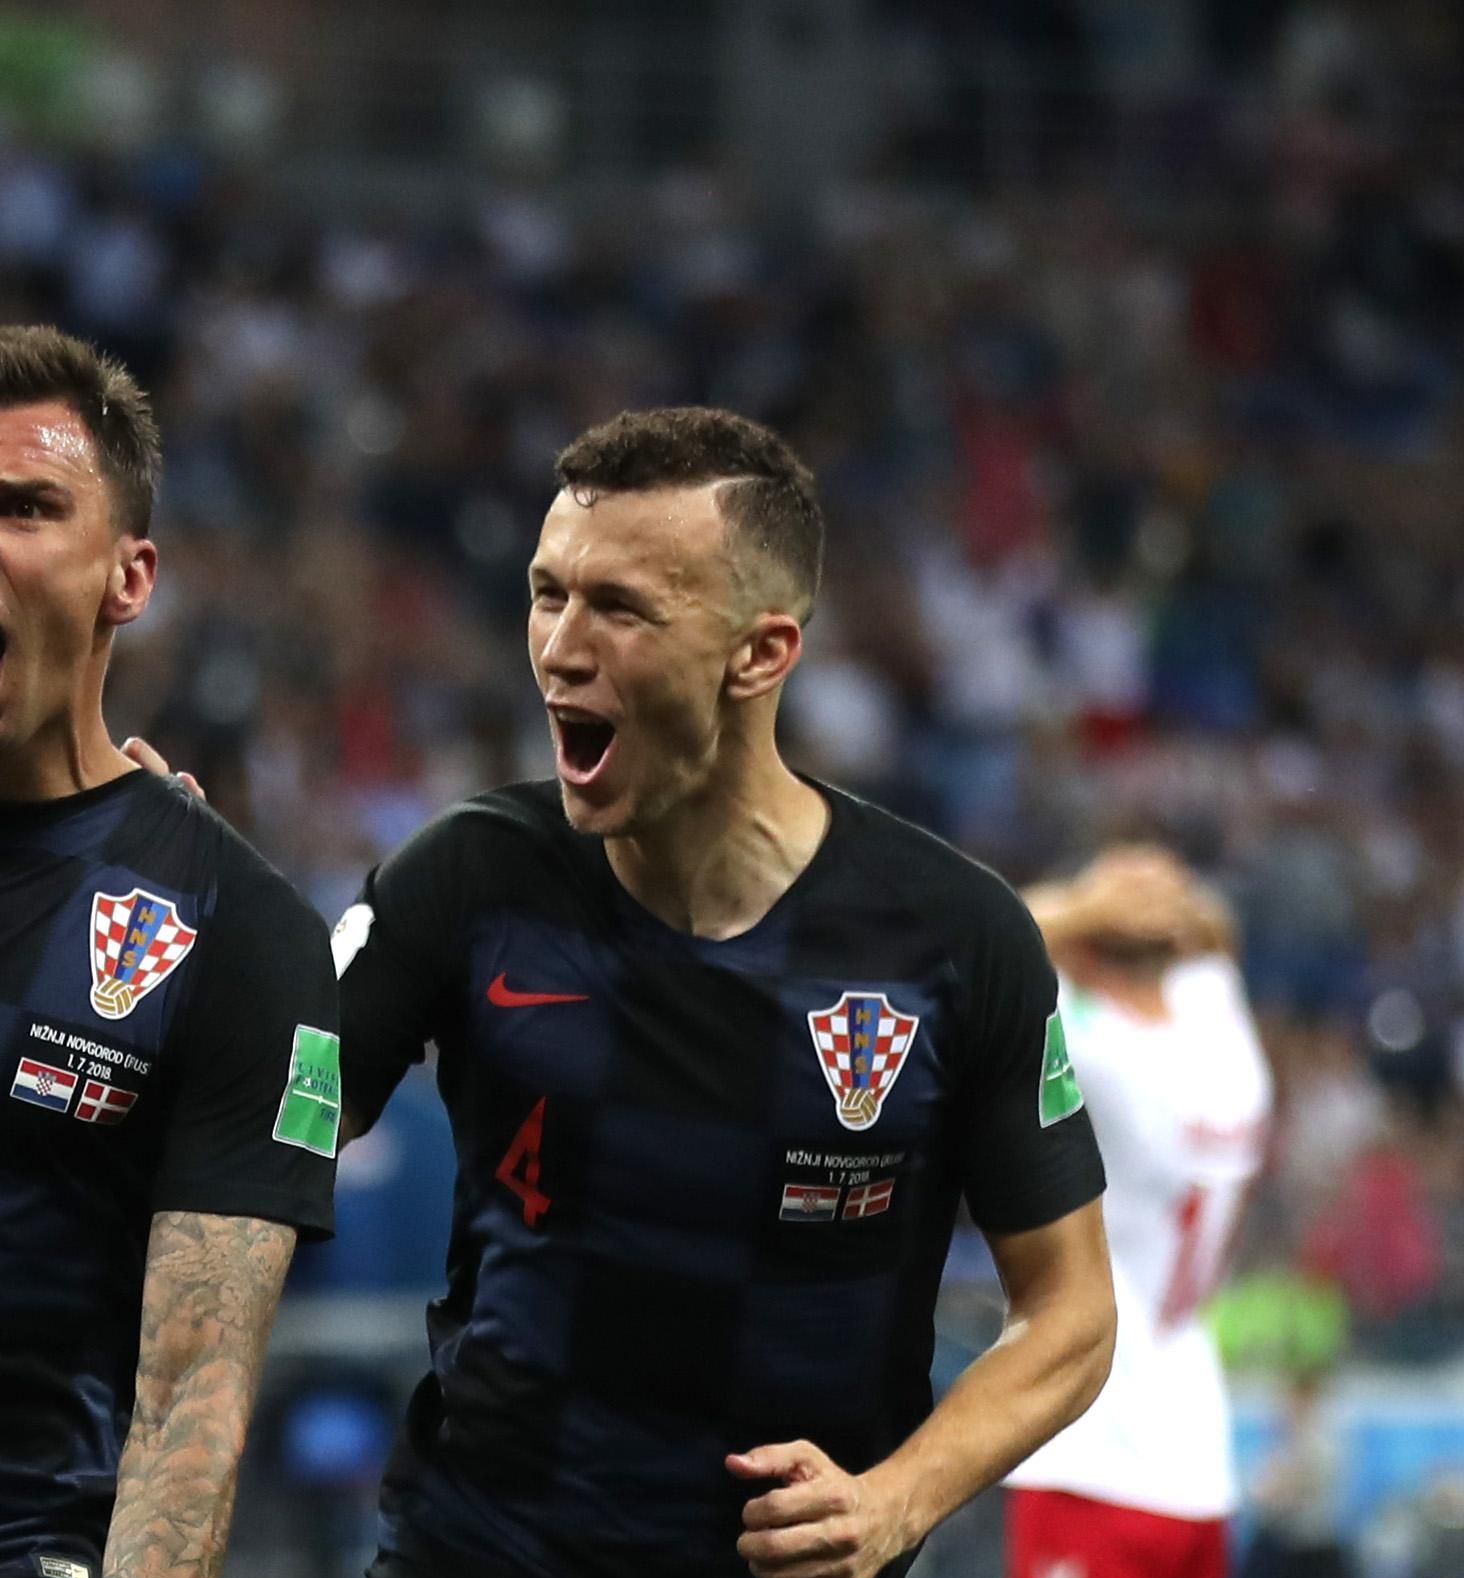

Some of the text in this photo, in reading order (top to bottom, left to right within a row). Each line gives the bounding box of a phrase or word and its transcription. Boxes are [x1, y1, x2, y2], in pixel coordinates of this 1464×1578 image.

[122, 906, 156, 968] HNS
[30, 1023, 152, 1075] NIŽNJI NOVGOROD (RUS
[495, 1095, 552, 1227] 4
